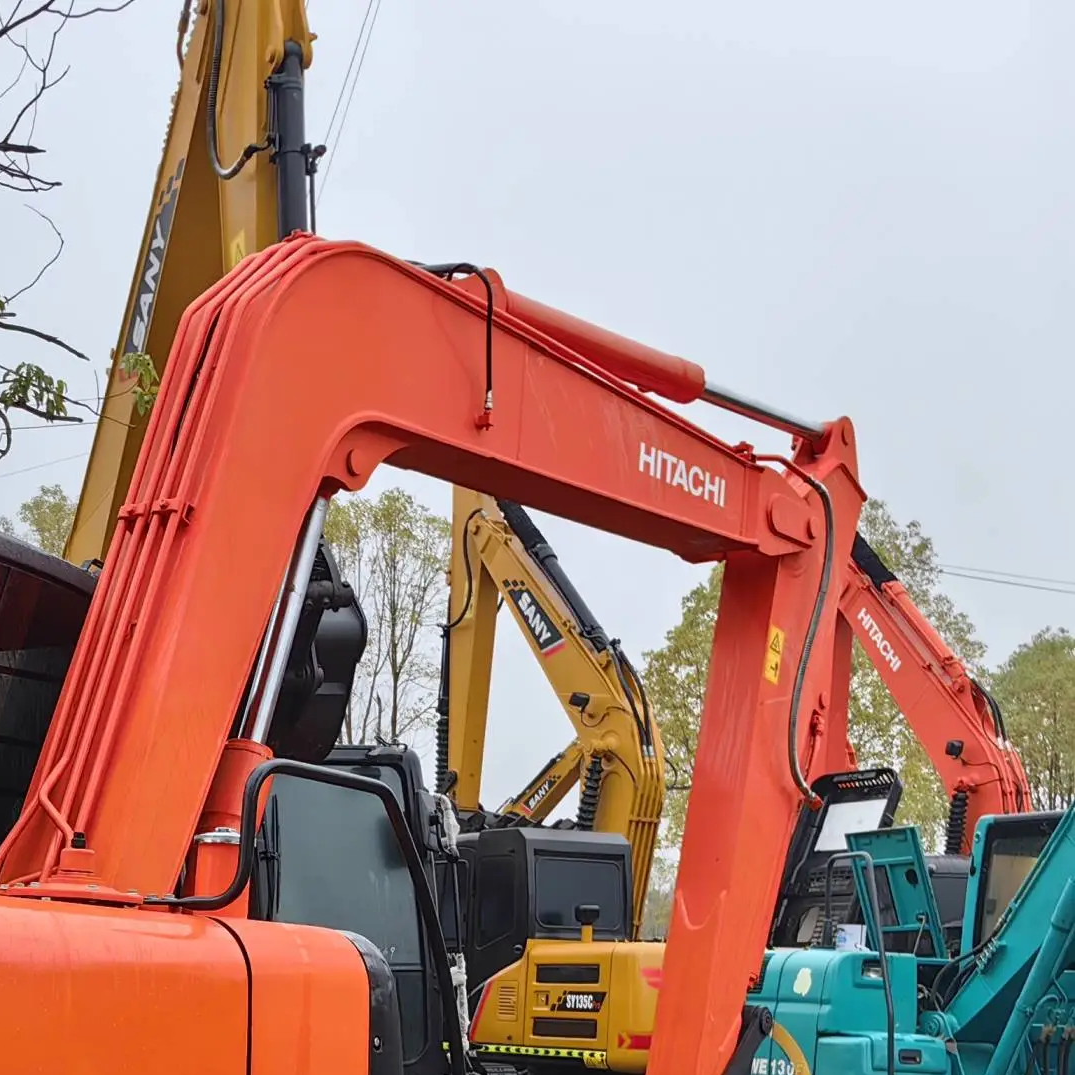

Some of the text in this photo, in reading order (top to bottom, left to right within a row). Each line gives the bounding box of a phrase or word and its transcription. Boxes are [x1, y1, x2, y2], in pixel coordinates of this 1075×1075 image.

[132, 217, 165, 353] SANY
[638, 441, 726, 509] HITACHI
[517, 591, 552, 644] SANY
[857, 607, 902, 672] HITACHI
[528, 780, 550, 810] SANY
[566, 994, 593, 1009] SY135C
